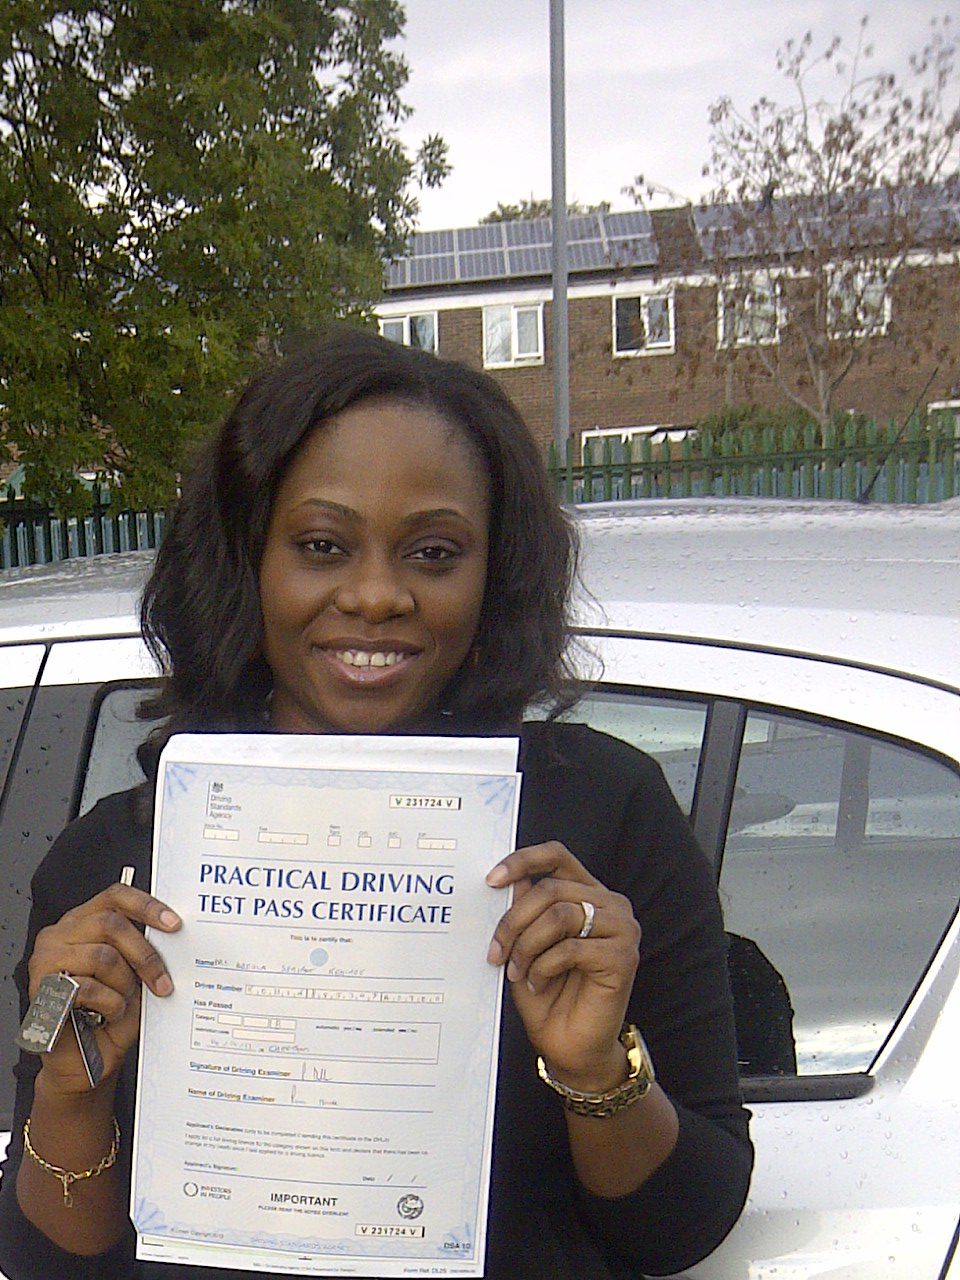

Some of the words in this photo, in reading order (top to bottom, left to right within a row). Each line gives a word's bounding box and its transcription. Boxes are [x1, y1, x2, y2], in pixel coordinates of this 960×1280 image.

[406, 798, 442, 807] 231724
[199, 863, 332, 890] PRACTICAL
[341, 871, 454, 895] DRIVING
[198, 894, 246, 915] TEST
[253, 898, 304, 919] PASS
[311, 901, 452, 924] CERTIFICATE
[232, 1066, 256, 1076] Driving
[188, 1087, 207, 1096] Name
[270, 1193, 338, 1207] IMPORTANT
